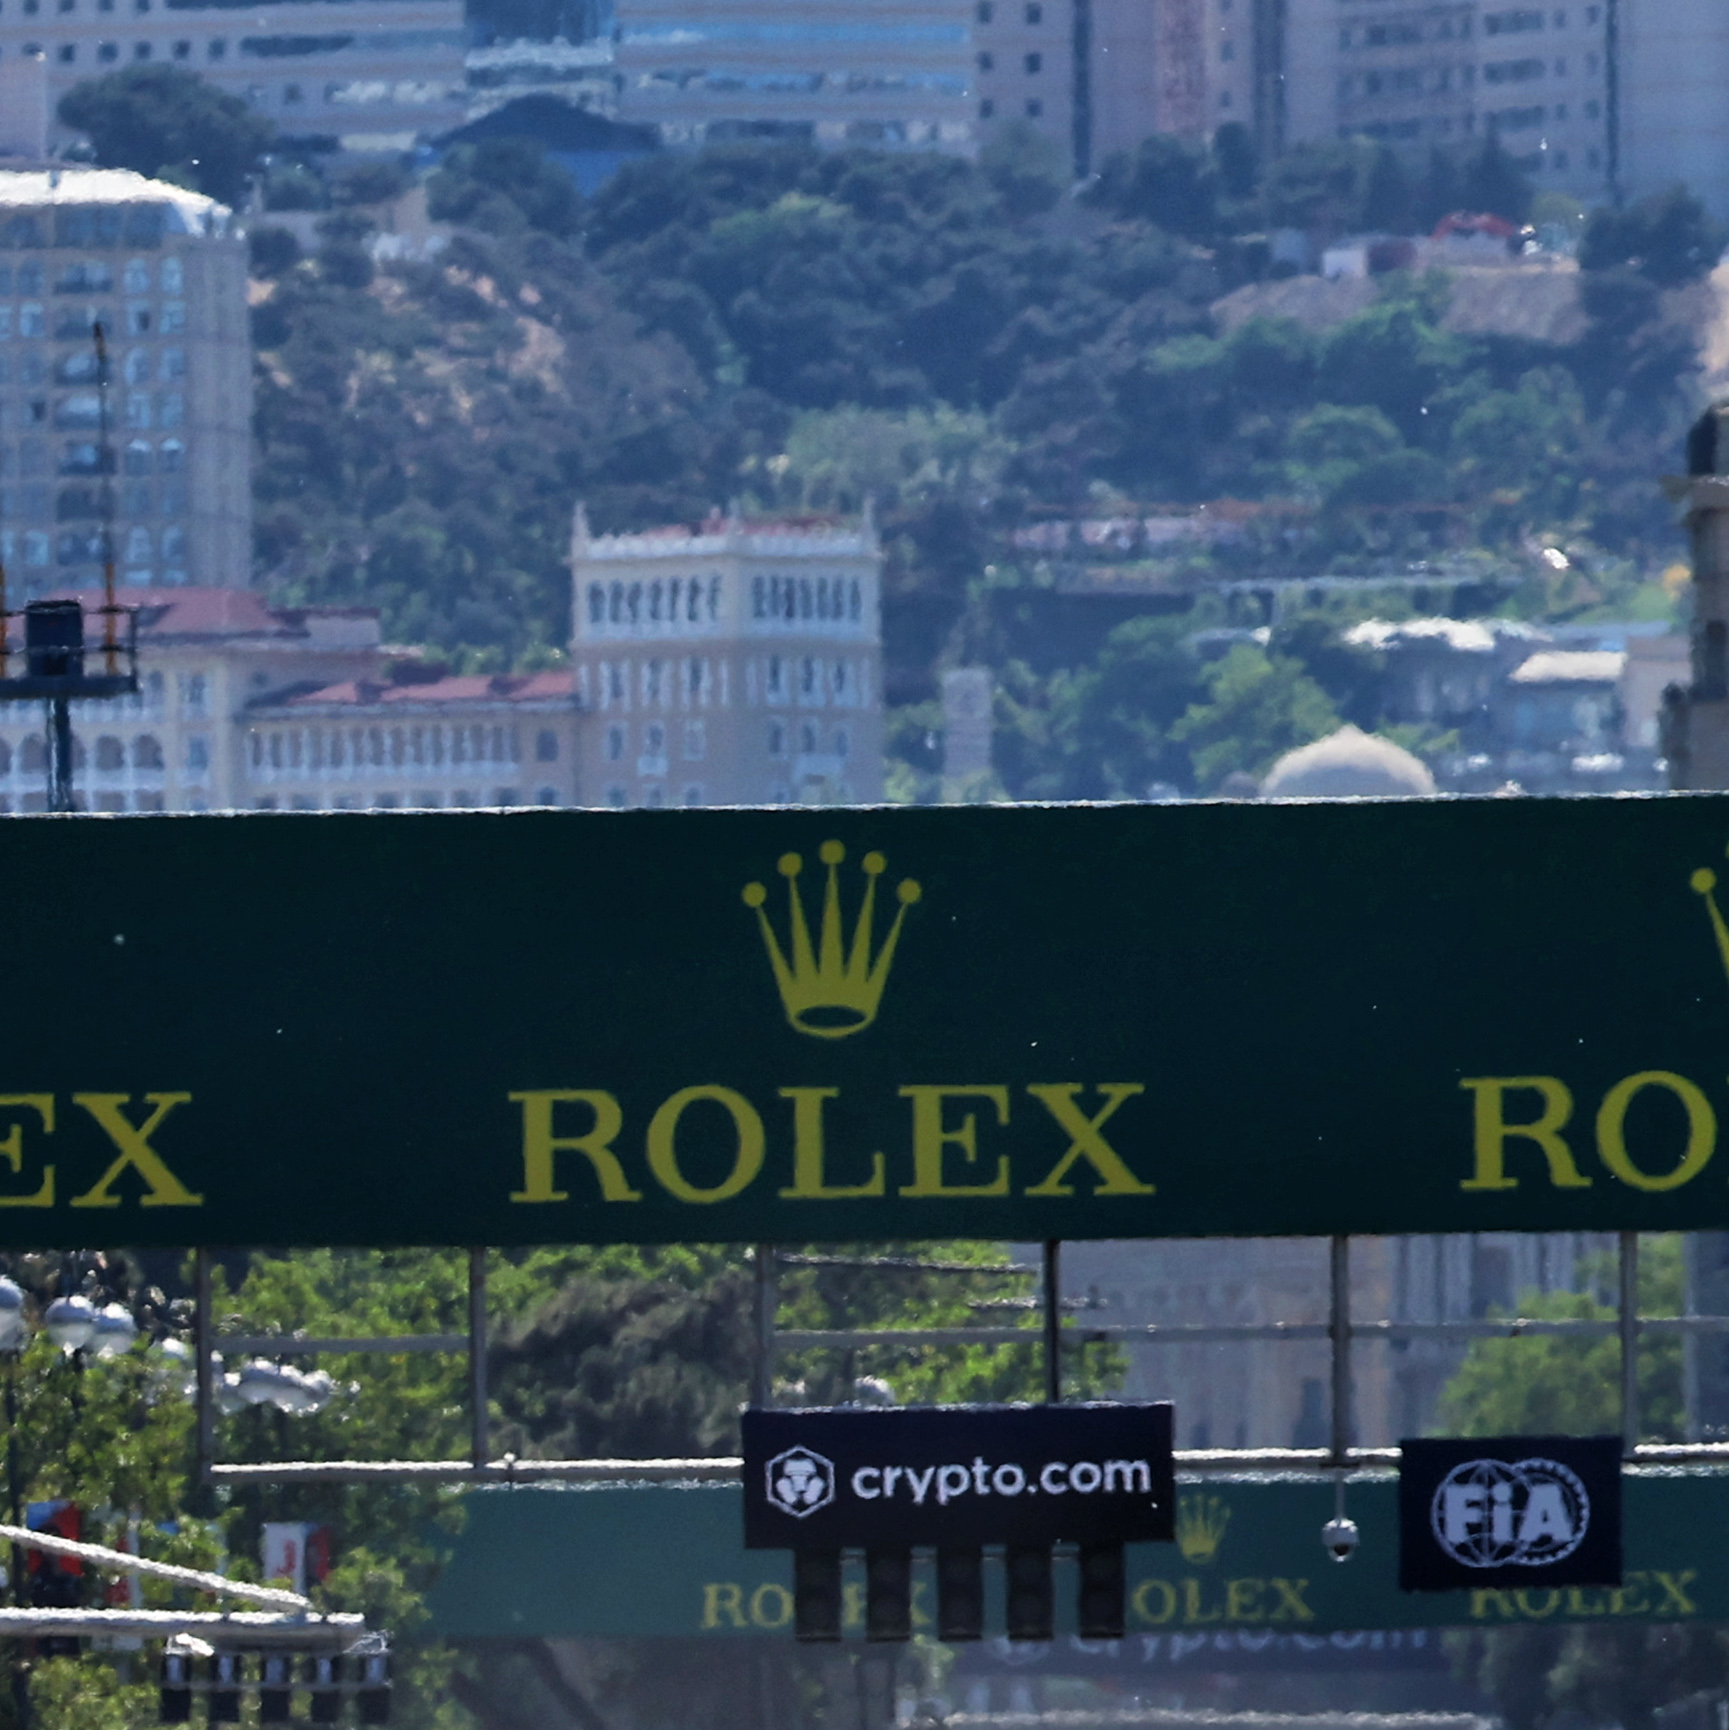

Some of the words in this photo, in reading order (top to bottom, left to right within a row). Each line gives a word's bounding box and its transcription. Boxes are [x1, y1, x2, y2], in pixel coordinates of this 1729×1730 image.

[508, 1083, 1155, 1204] ROLEX
[851, 1447, 1152, 1508] crypto.com
[1130, 1577, 1316, 1625] OLEX
